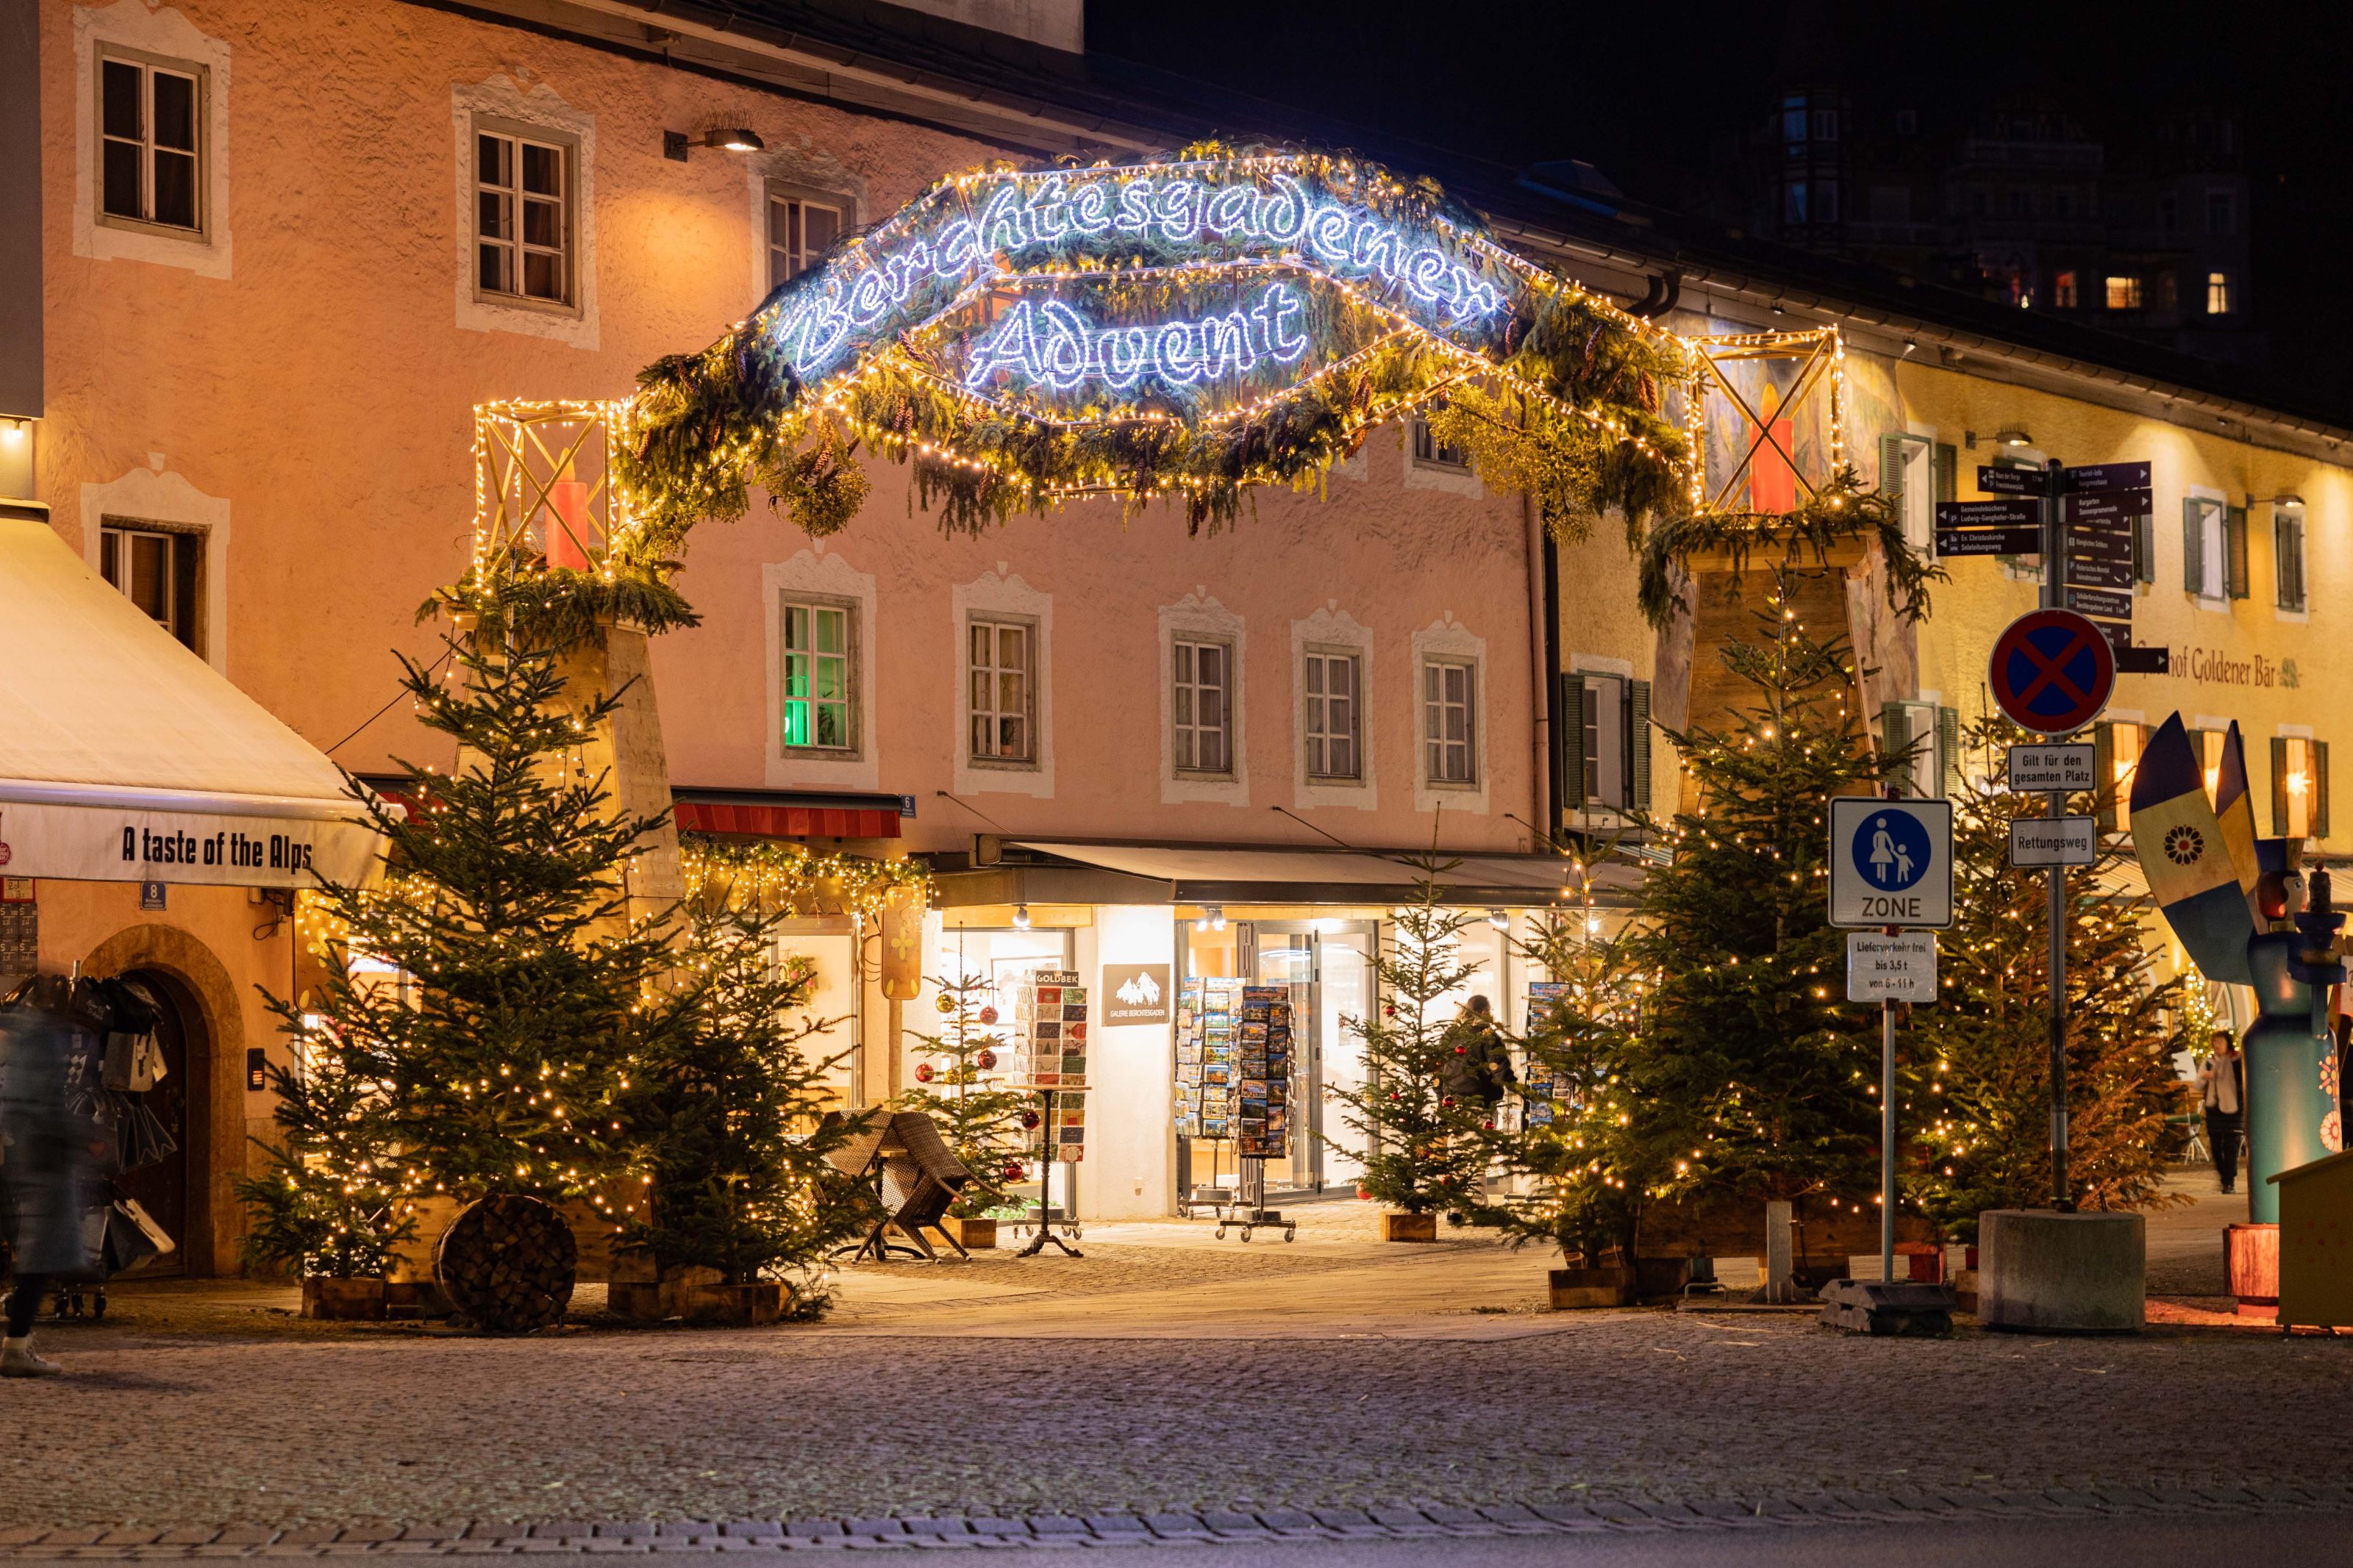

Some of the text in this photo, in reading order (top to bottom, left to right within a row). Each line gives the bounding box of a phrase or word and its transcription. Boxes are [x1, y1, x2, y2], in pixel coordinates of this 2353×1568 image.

[776, 173, 1500, 373] Berchtesgadener
[965, 281, 1307, 389] Advent
[1960, 504, 2007, 513] Gemeindebücherei
[1960, 514, 2026, 523] Ludwig-Ganghofer-Straße
[1969, 533, 2005, 541] Christuskirche
[1961, 543, 2002, 551] Soleleitungsweg
[2192, 647, 2251, 686] Goldener
[2254, 654, 2276, 687] Bär
[2023, 754, 2082, 767] Gilt für den
[2015, 770, 2090, 785] gesamten Platz
[905, 796, 910, 809] 6
[2018, 836, 2087, 851] Rettungsweg
[122, 826, 313, 875] A taste of the Alps
[150, 884, 157, 898] 8
[1862, 897, 1921, 917] ZONE
[1857, 942, 1927, 953] Lieferverkehr frei
[1876, 960, 1907, 972] bis 3,5 t
[1036, 974, 1079, 984] GOLDBEK
[1869, 980, 1883, 988] von
[1885, 978, 1890, 988] 6
[1898, 978, 1906, 988] 11
[1909, 978, 1915, 988] h
[1110, 1009, 1165, 1017] GALERIE BERCHTESGADEN
